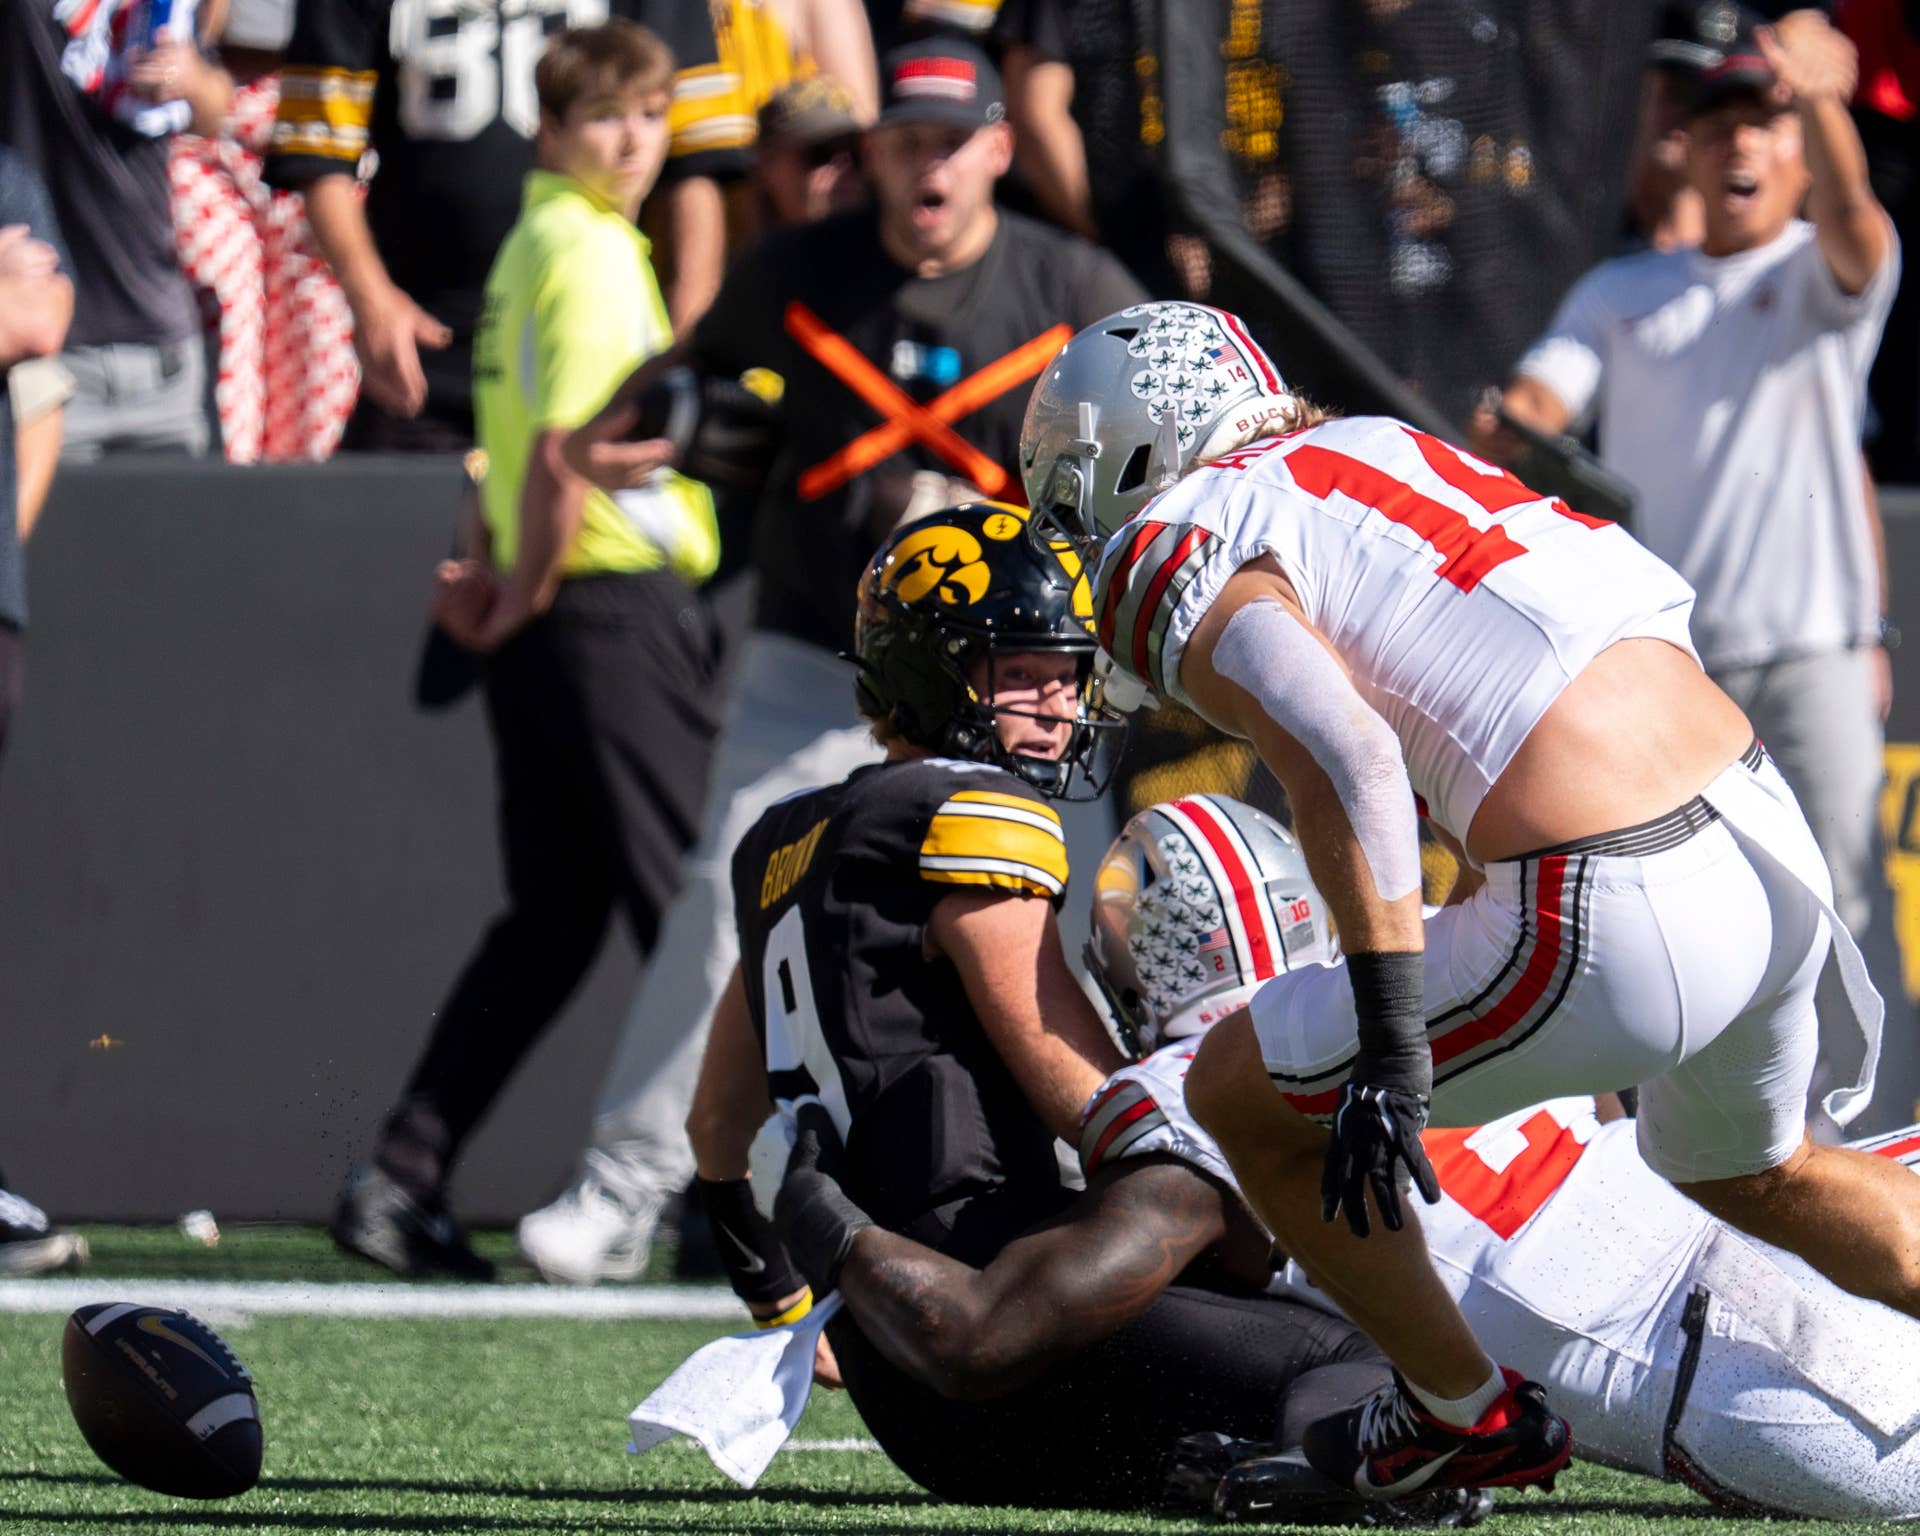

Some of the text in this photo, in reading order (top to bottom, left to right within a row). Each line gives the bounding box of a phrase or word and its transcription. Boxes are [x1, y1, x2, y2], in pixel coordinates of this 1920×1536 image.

[1227, 365, 1248, 383] 14
[1236, 405, 1297, 432] BUCK
[1213, 954, 1226, 972] 2
[762, 903, 852, 1149] 9
